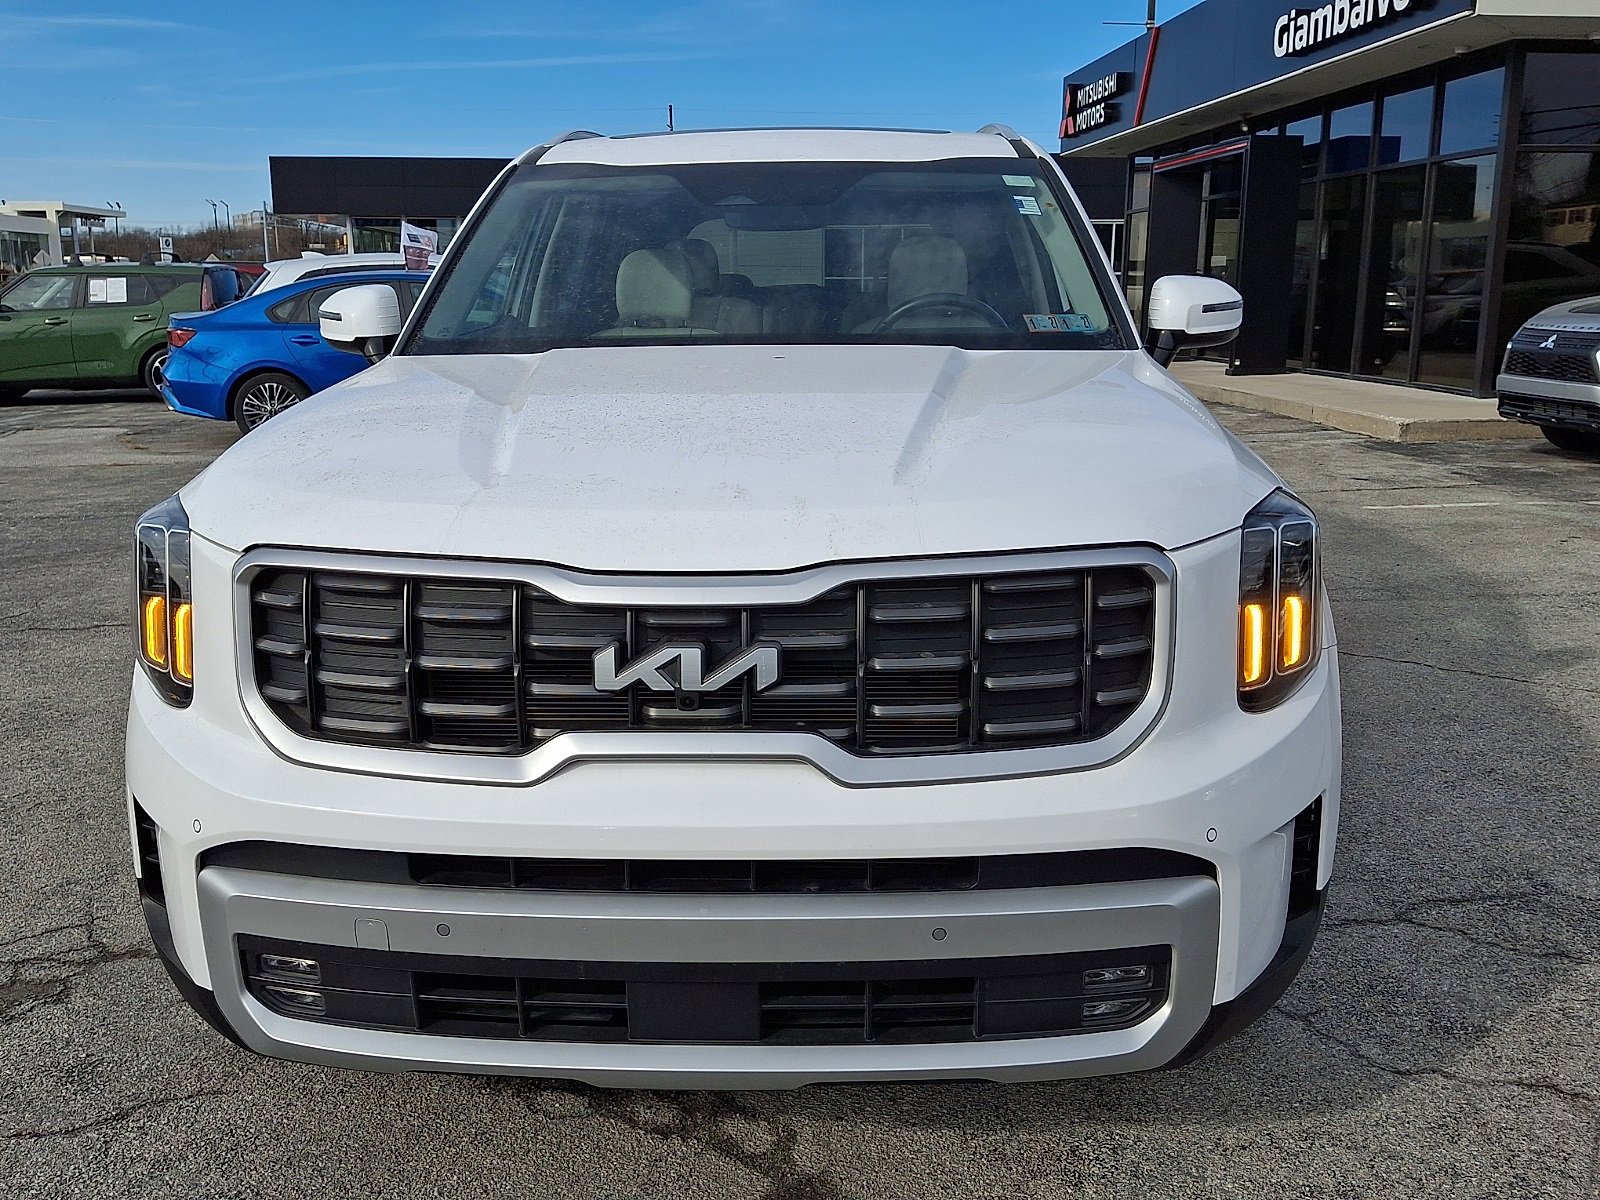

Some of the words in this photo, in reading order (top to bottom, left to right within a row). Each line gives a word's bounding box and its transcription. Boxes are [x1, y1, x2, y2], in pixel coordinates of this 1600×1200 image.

[1077, 72, 1117, 109] MITSUBISHI
[1076, 102, 1105, 132] MOTORS
[594, 646, 778, 692] KIA
